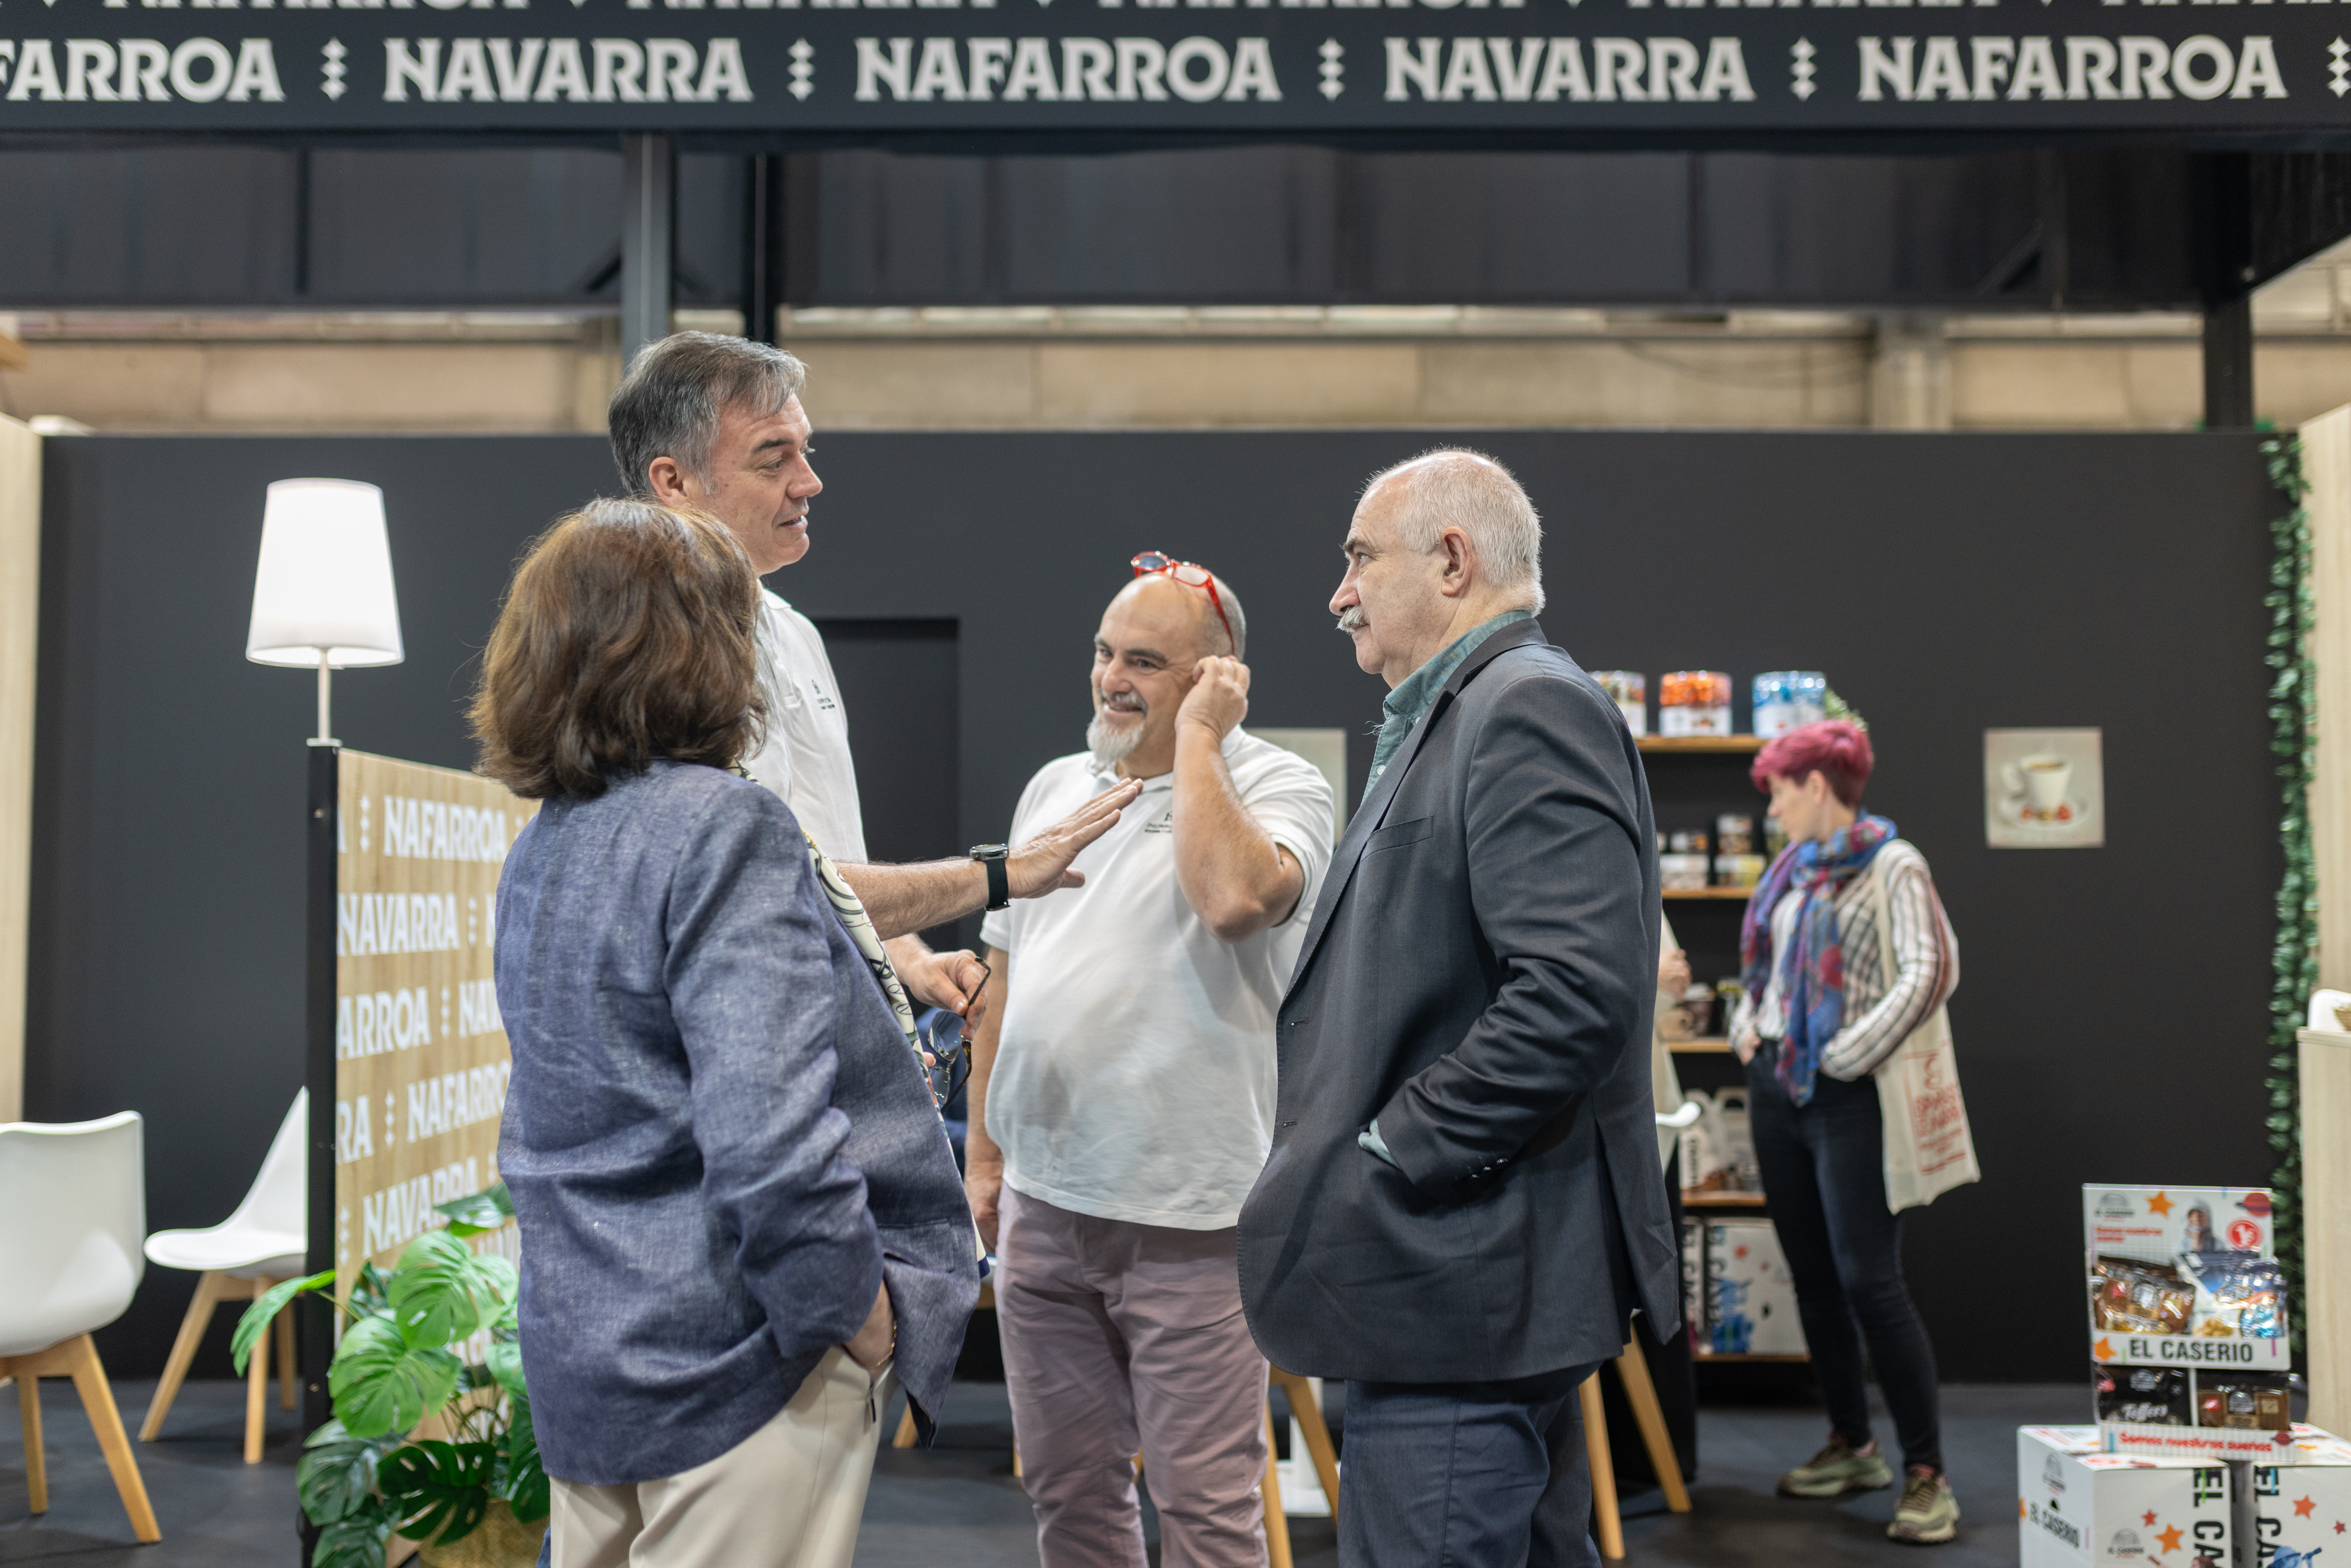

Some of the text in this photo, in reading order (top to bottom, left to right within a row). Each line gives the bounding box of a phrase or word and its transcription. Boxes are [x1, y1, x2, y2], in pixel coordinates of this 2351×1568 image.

[383, 38, 754, 103] NAVARRA
[855, 36, 1283, 102] NAFARROA
[1384, 36, 1756, 102] NAVARRA
[1857, 35, 2288, 101] NAFARROA
[383, 794, 507, 863] NAFARROA
[338, 892, 460, 957] NAVARRA
[2129, 1339, 2254, 1363] EL CASERIO
[2119, 1431, 2162, 1446] Somos
[2166, 1437, 2224, 1450] nuestros
[2193, 1520, 2225, 1563] CA
[2255, 1516, 2283, 1568] CA
